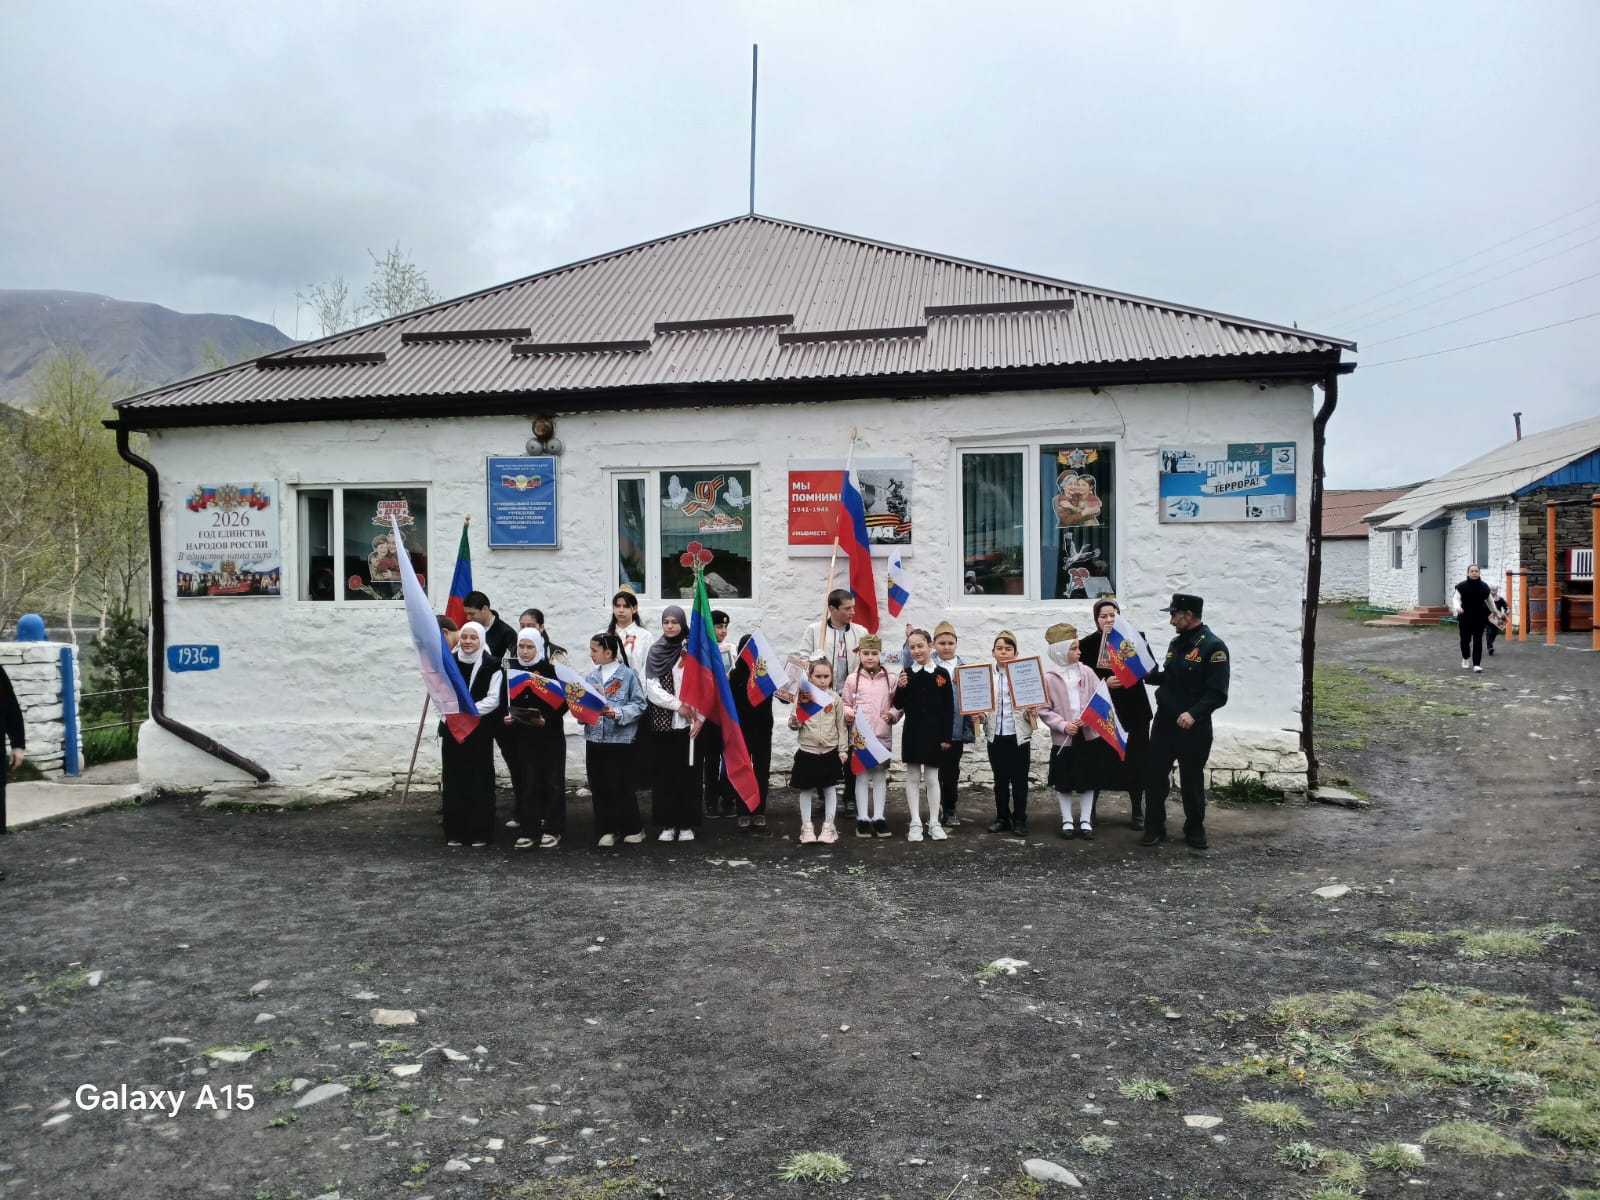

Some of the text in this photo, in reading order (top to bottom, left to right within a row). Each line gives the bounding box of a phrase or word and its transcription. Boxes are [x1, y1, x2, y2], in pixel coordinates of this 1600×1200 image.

[1206, 460, 1259, 477] РОССИЯ
[792, 482, 810, 490] МЫ
[1214, 478, 1259, 493] ТЕРРОРА!
[792, 493, 841, 502] ПОМНИМ!
[212, 511, 250, 527] 2026
[198, 529, 266, 539] ГОД ЕДИНСТВА
[186, 541, 269, 551] НАРОДОВ РОССИИ
[177, 552, 185, 560] В
[227, 552, 250, 560] наша
